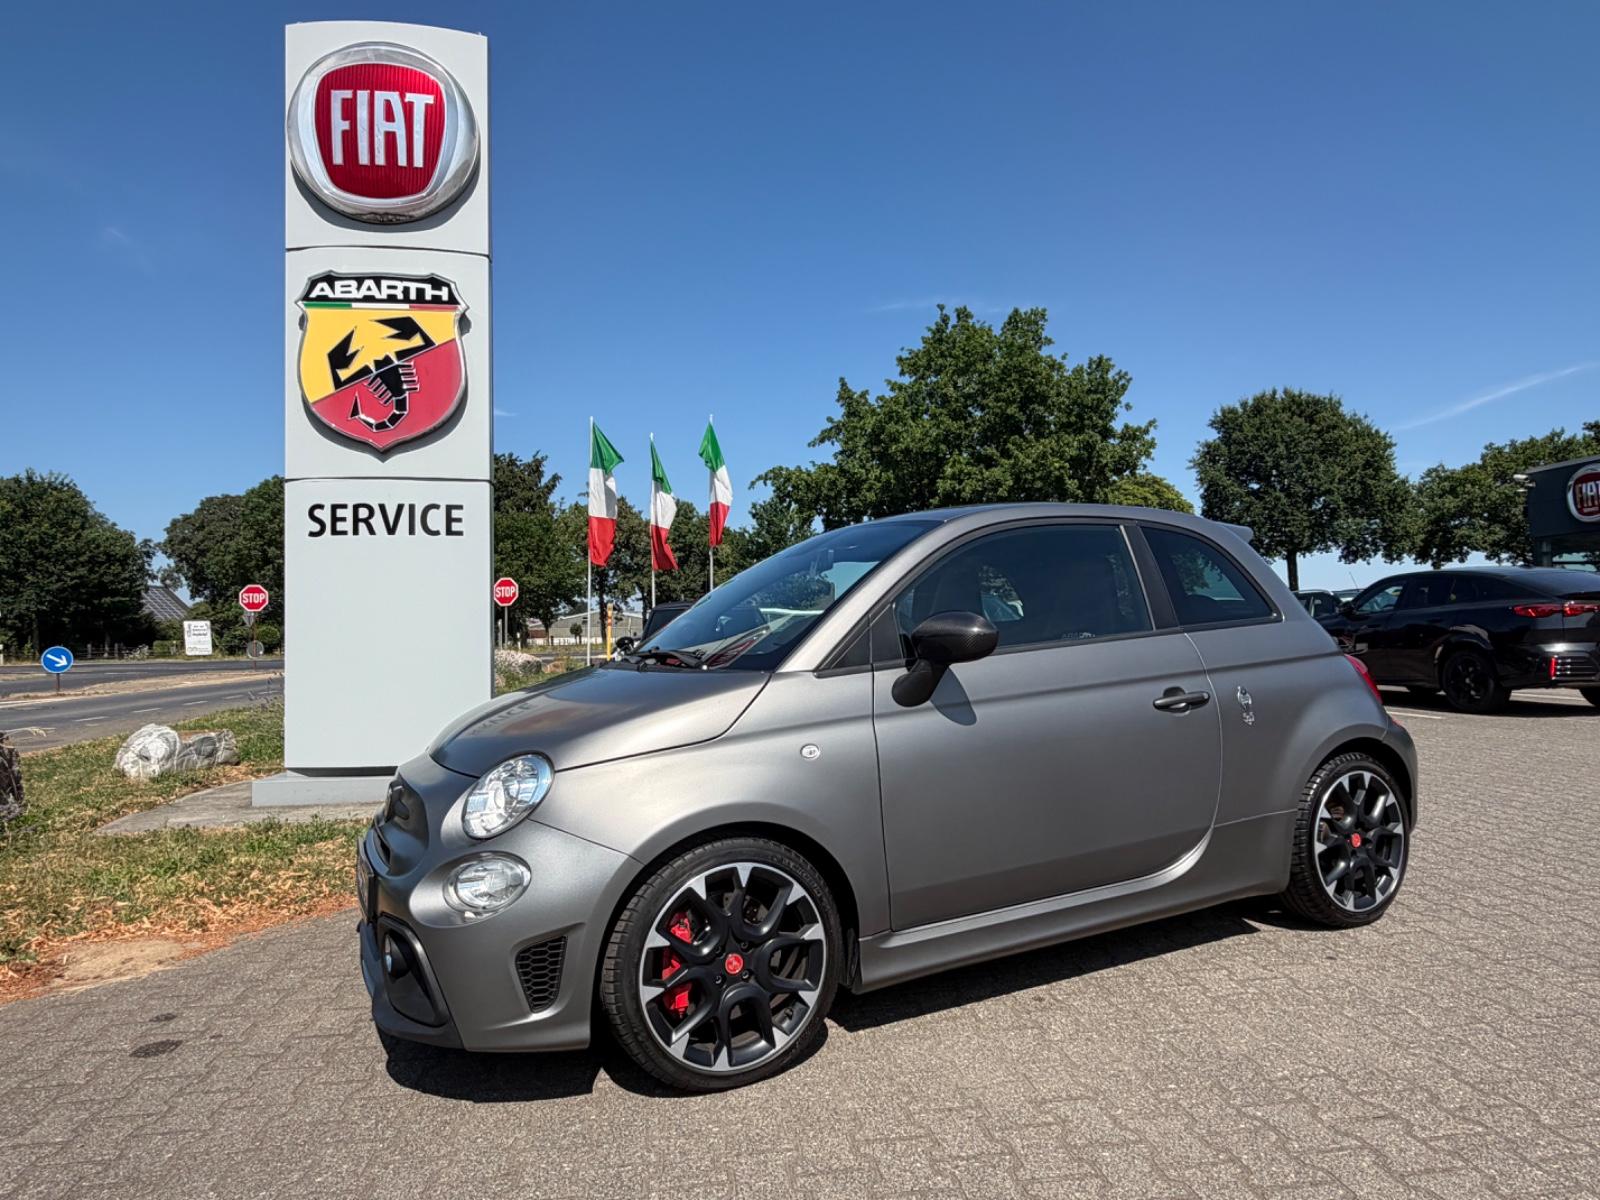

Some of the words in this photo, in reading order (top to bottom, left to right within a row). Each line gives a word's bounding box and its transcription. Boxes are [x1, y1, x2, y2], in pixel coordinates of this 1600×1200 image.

[331, 89, 435, 168] FIAT
[308, 279, 449, 301] ABARTH
[308, 502, 464, 538] SERVICE
[242, 592, 266, 605] STOP
[495, 586, 516, 598] STOP
